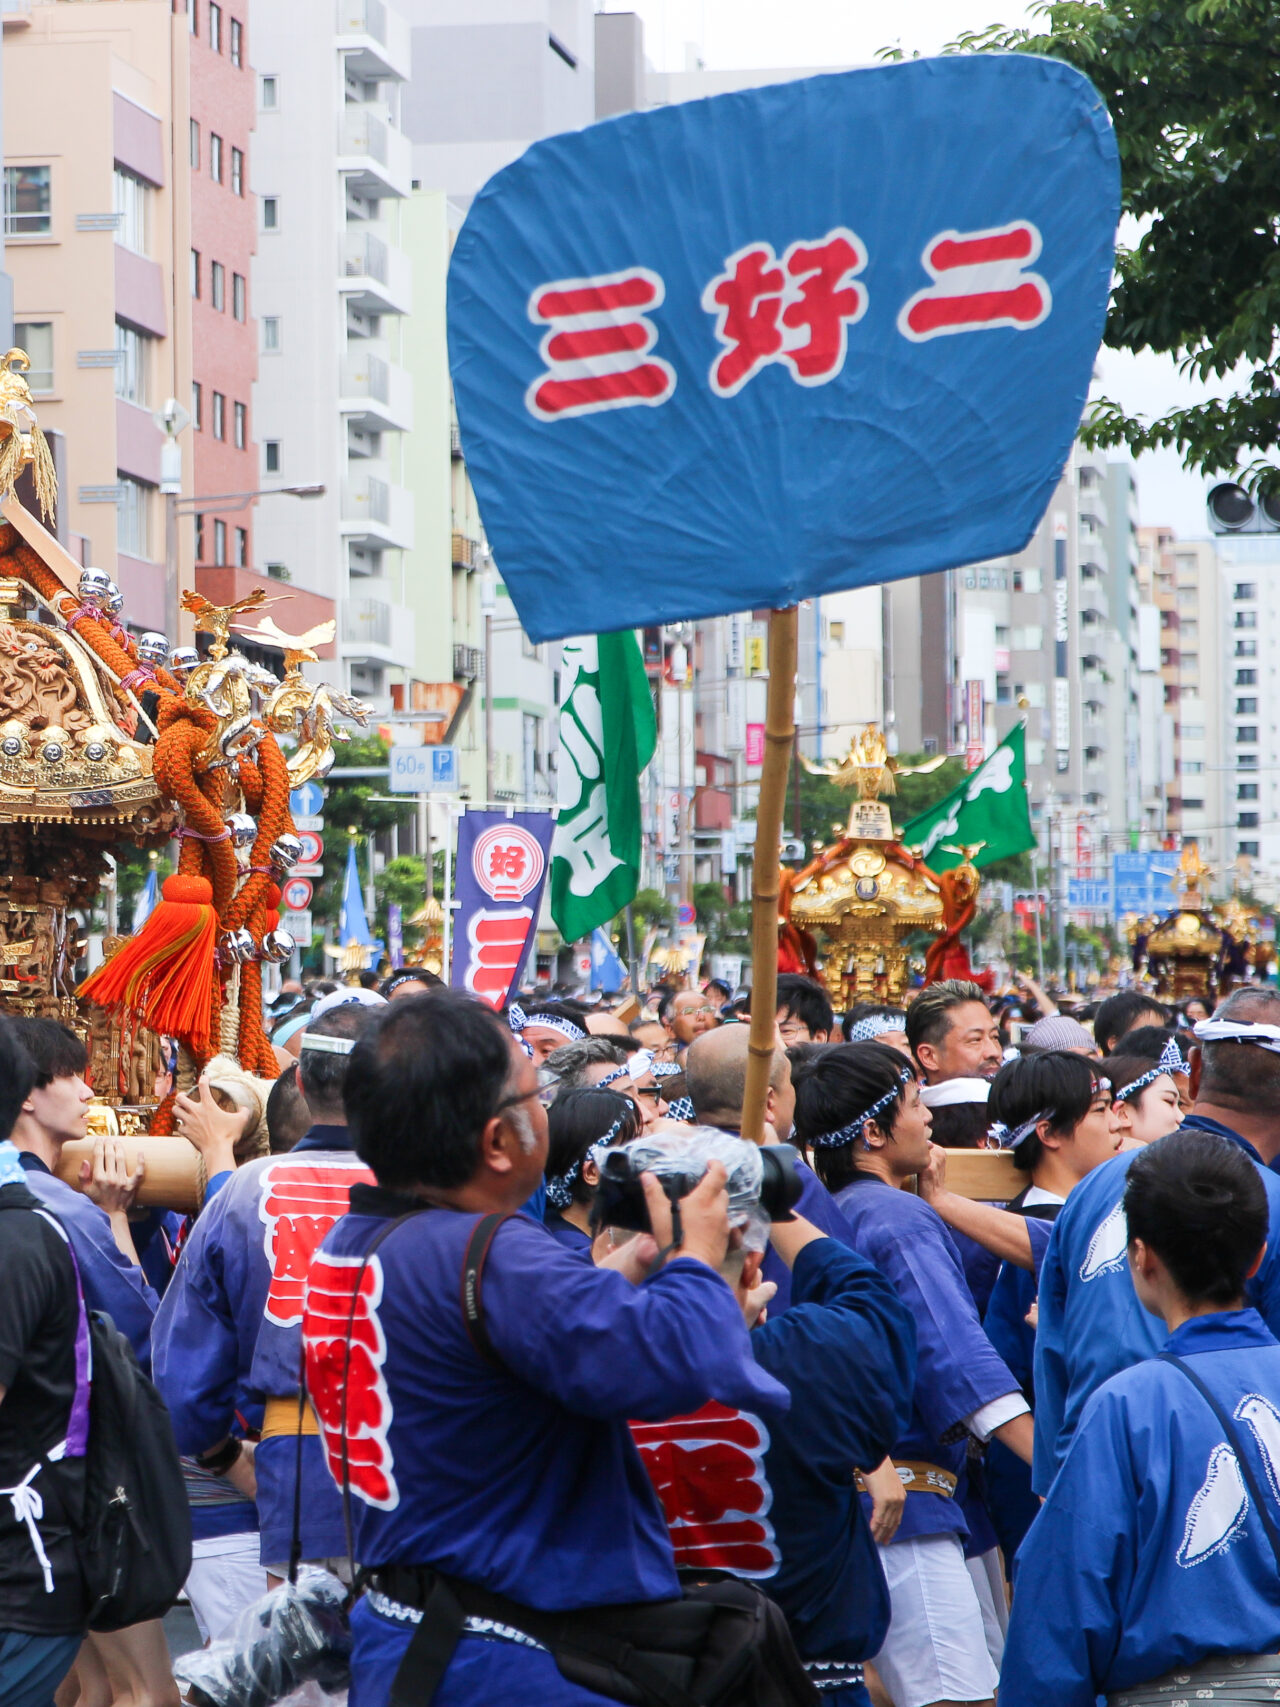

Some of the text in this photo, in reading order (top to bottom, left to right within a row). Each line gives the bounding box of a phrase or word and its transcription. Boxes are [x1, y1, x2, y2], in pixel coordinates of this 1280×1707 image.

[528, 222, 1049, 419] 三好二
[1056, 579, 1068, 642] TOMAS
[466, 1268, 478, 1320] Canon
